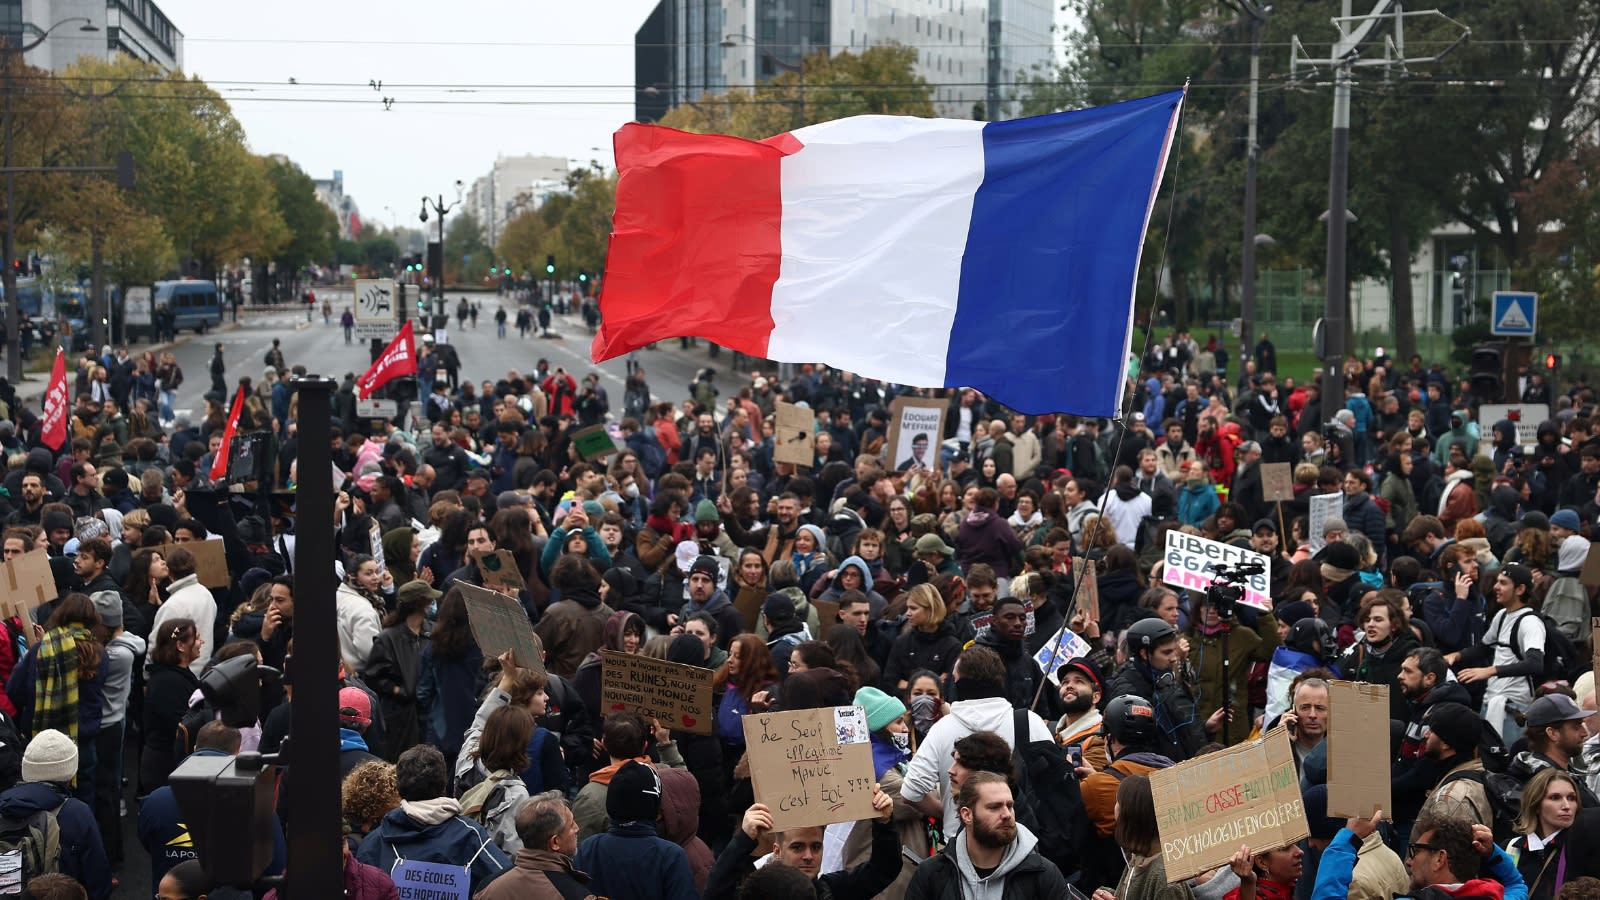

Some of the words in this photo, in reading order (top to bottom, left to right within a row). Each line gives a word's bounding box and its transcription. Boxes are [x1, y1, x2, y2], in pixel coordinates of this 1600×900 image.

[605, 658, 627, 668] NOUS
[665, 666, 679, 676] PAS
[685, 670, 707, 680] PEUR
[605, 669, 623, 679] DES
[670, 680, 697, 692] NOUS
[604, 680, 641, 692] PORTONS
[643, 685, 654, 693] UN
[657, 688, 696, 704] MONDE
[604, 690, 644, 704] NOUVEAU
[651, 697, 675, 708] DANS
[680, 704, 701, 715] NOS
[760, 717, 782, 743] Le
[790, 719, 822, 740] Seul
[779, 789, 809, 811] c'est
[821, 783, 844, 804] toi
[1205, 784, 1244, 814] CASSE
[1163, 818, 1246, 862] PSYCHOLOGUE
[165, 850, 179, 858] LA
[404, 869, 422, 882] DES
[423, 868, 457, 888] ÉCOLES,
